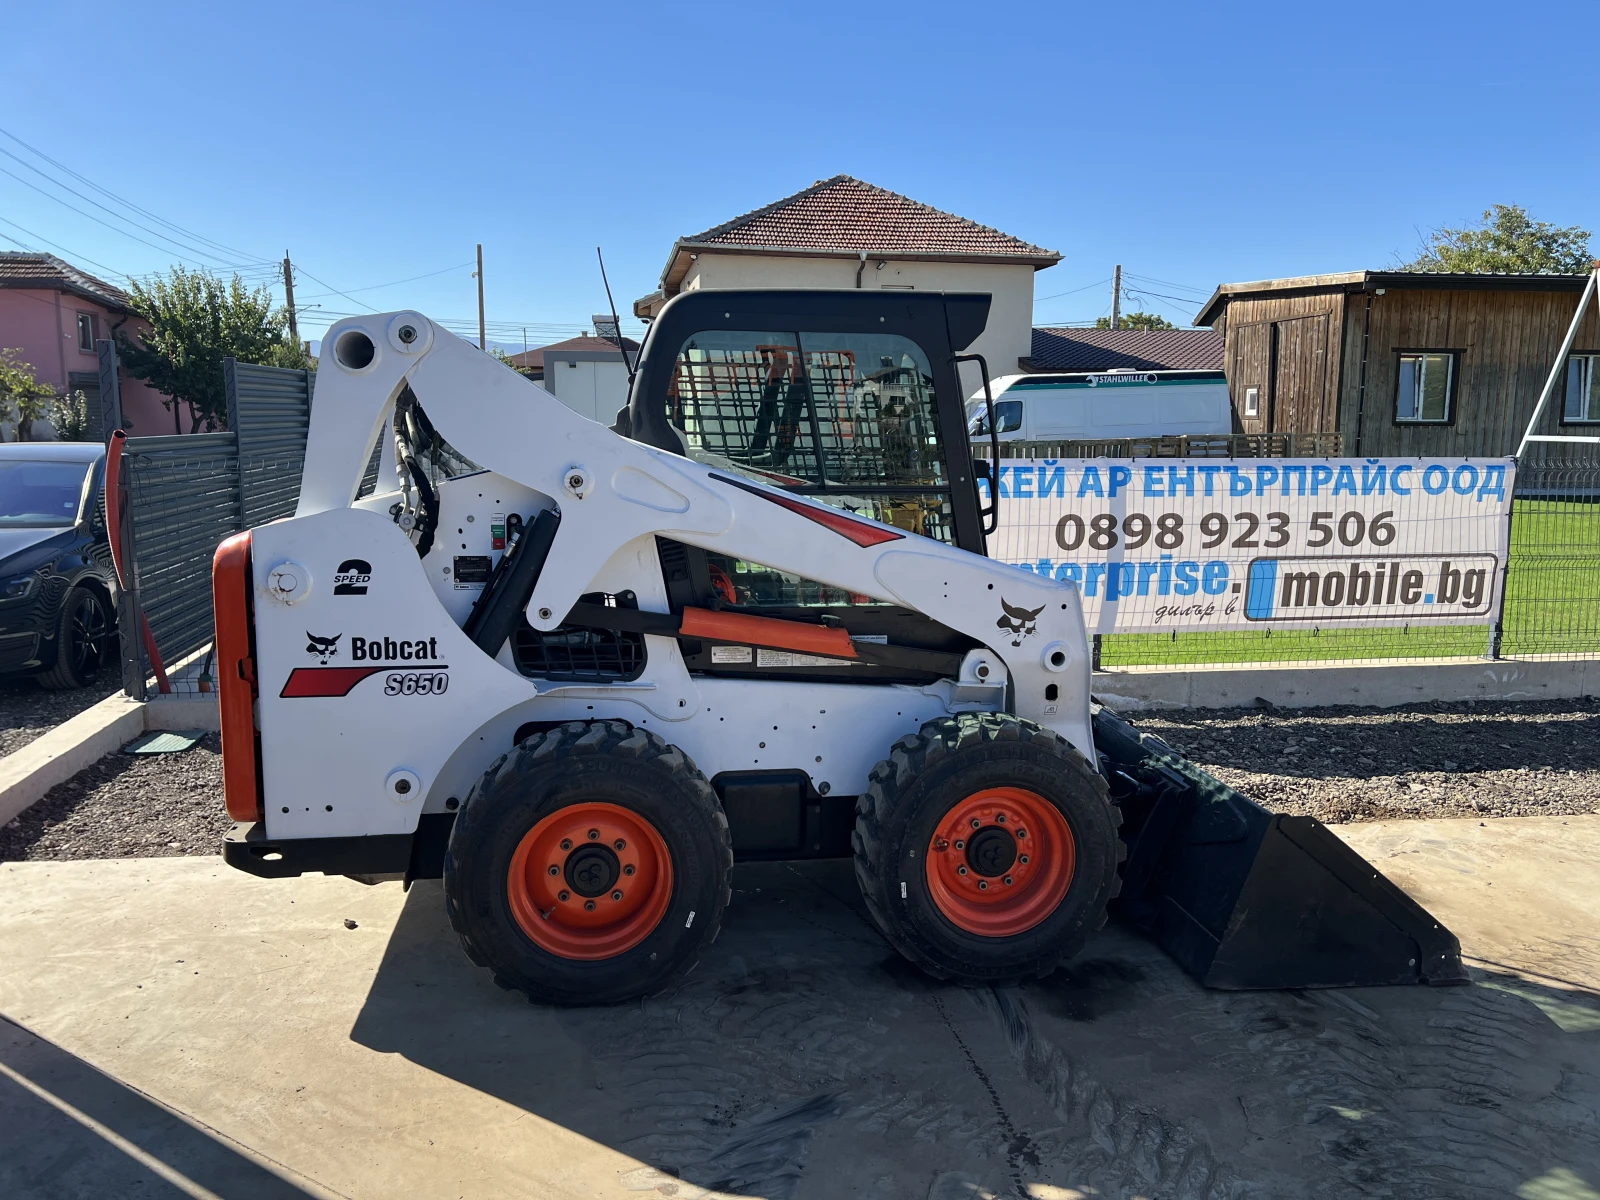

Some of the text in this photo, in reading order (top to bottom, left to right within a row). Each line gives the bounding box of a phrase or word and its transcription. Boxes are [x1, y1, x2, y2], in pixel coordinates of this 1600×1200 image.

[1099, 375, 1144, 383] STAHLWILLE
[1076, 466, 1132, 498] АР
[1143, 459, 1413, 497] ЕНТЪРПРАЙС
[1422, 464, 1506, 503] ООД
[1055, 510, 1397, 551] 0898 923 506
[333, 575, 371, 583] SPEED
[1281, 561, 1487, 608] mobile.bg
[351, 637, 438, 661] Bobcat
[384, 673, 449, 696] S650
